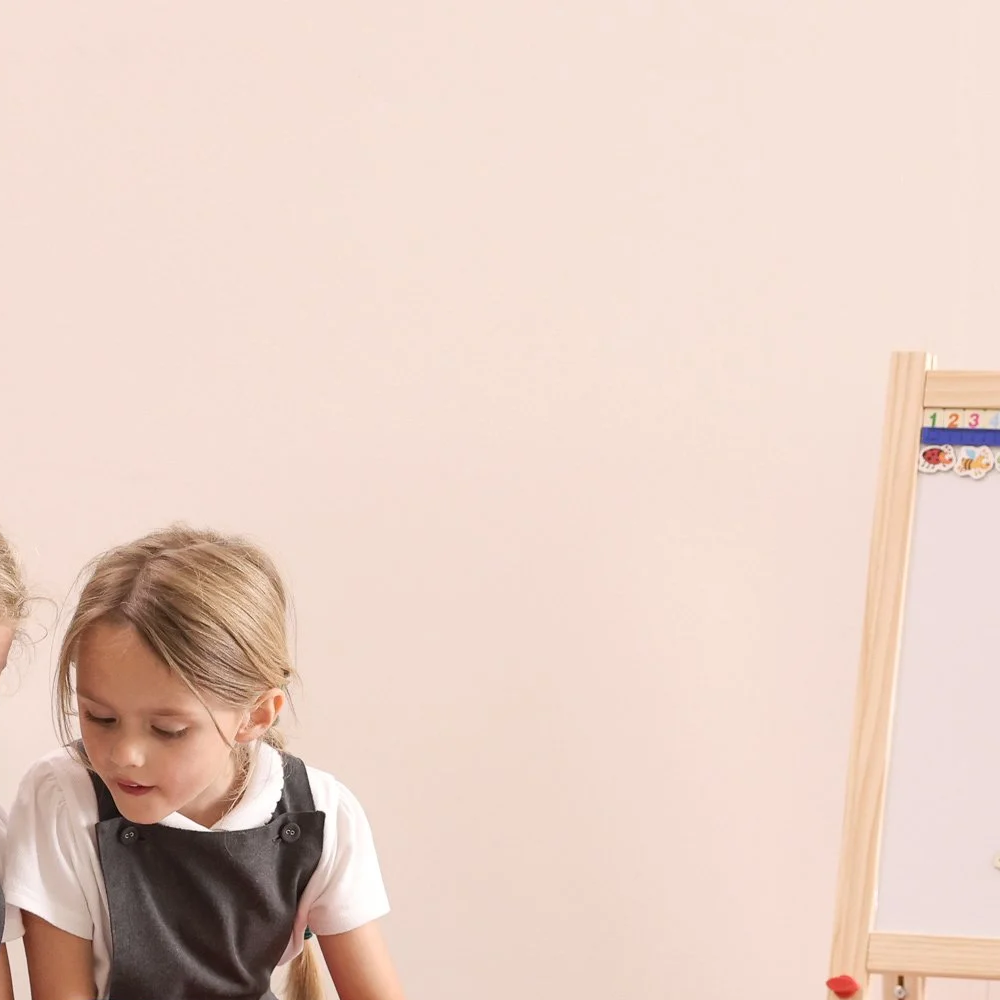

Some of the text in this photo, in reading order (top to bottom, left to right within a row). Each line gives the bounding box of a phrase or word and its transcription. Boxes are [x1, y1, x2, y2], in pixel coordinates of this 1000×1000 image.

[929, 412, 937, 428] 1
[948, 413, 959, 429] 2
[969, 413, 980, 429] 3
